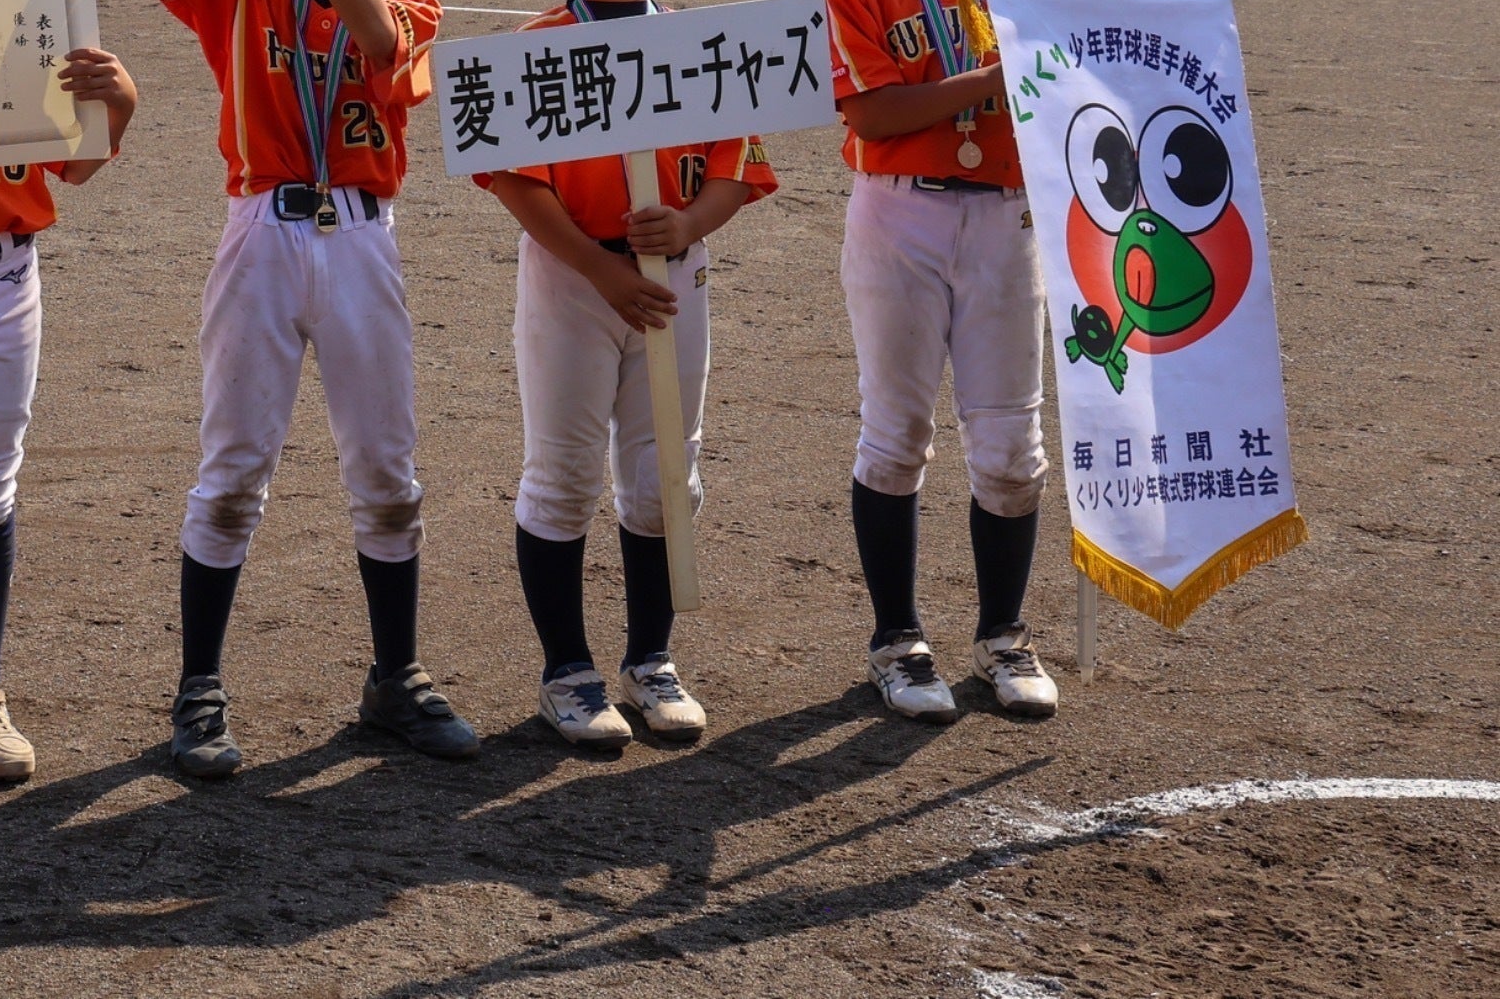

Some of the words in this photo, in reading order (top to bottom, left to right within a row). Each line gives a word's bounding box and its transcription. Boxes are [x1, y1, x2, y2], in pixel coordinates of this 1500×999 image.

[36, 13, 57, 70] 表彰状
[1012, 27, 1238, 124] くりくり少年野球選手権大会
[446, 11, 823, 153] 菱・境野フューチャーズ
[1072, 427, 1273, 471] 毎日新聞社
